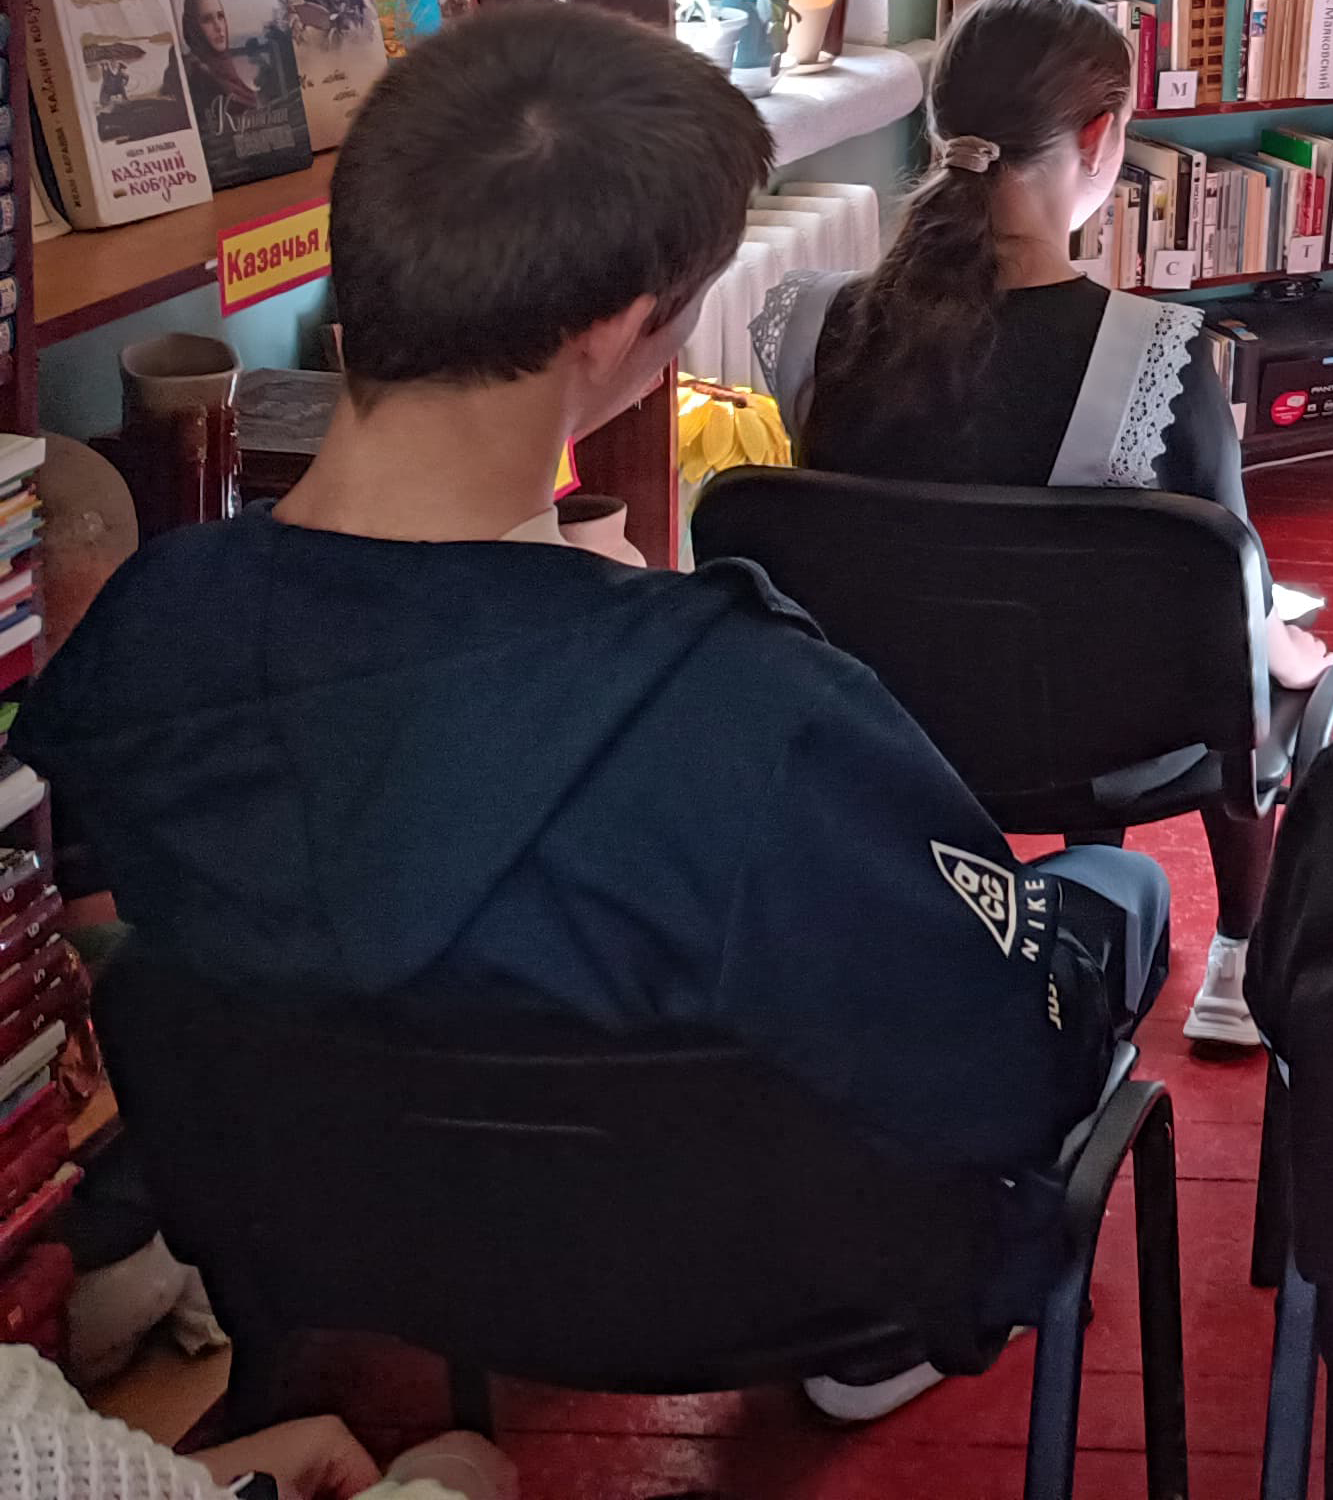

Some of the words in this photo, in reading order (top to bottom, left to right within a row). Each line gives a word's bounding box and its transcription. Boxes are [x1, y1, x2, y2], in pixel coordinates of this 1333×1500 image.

[1170, 82, 1188, 96] М
[111, 151, 186, 182] КАЗАЧИЙ
[128, 170, 198, 201] КОБЗАРЬ
[225, 228, 321, 286] Казачья
[1301, 244, 1315, 259] Т
[1165, 260, 1181, 276] С
[1021, 878, 1047, 963] NIKE
